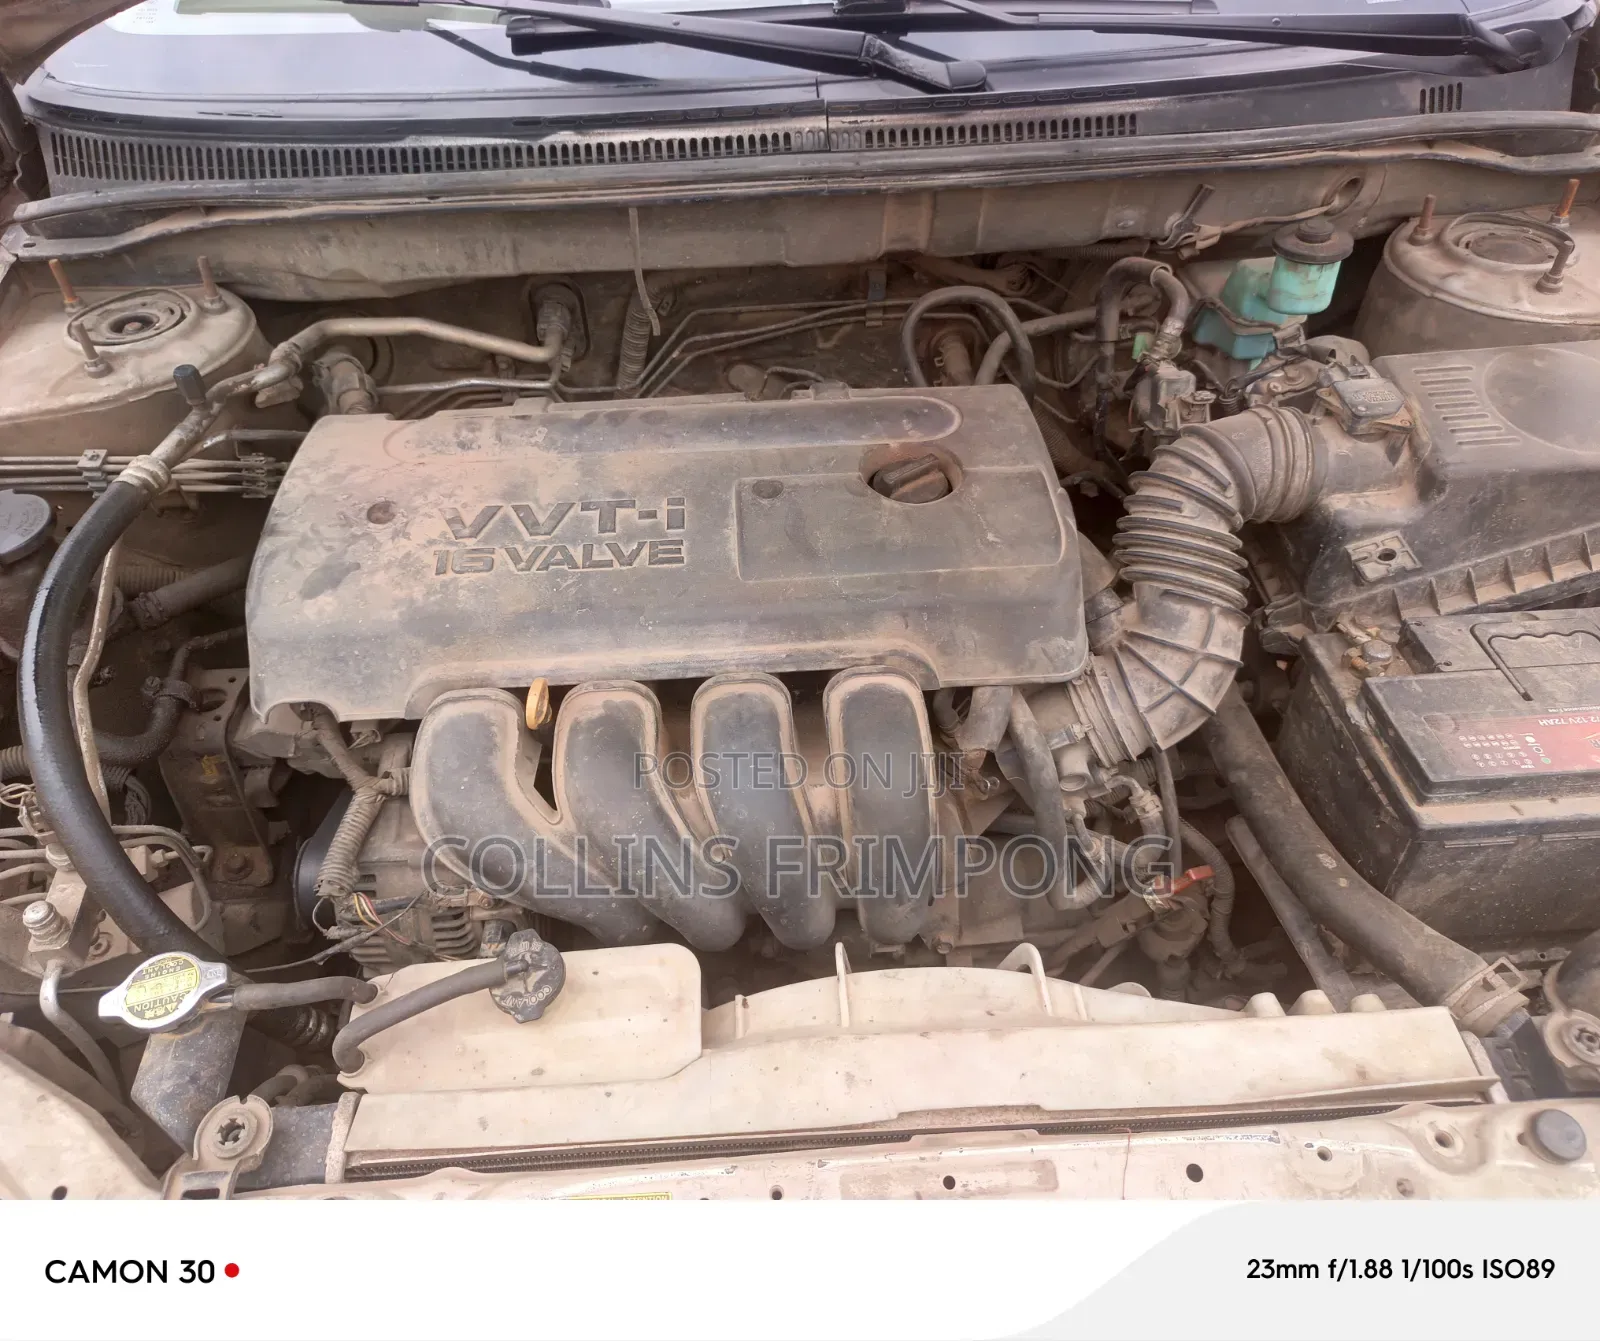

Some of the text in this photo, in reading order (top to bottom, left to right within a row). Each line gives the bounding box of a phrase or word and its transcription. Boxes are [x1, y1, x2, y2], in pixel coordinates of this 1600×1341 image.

[439, 497, 685, 539] VVT-i
[433, 539, 685, 575] 16 VALVE
[1538, 718, 1568, 727] 72AH
[141, 960, 184, 975] COOLANT
[144, 967, 181, 980] ENGINE
[134, 991, 188, 1013] CAUTION
[501, 985, 552, 1009] COOLANT
